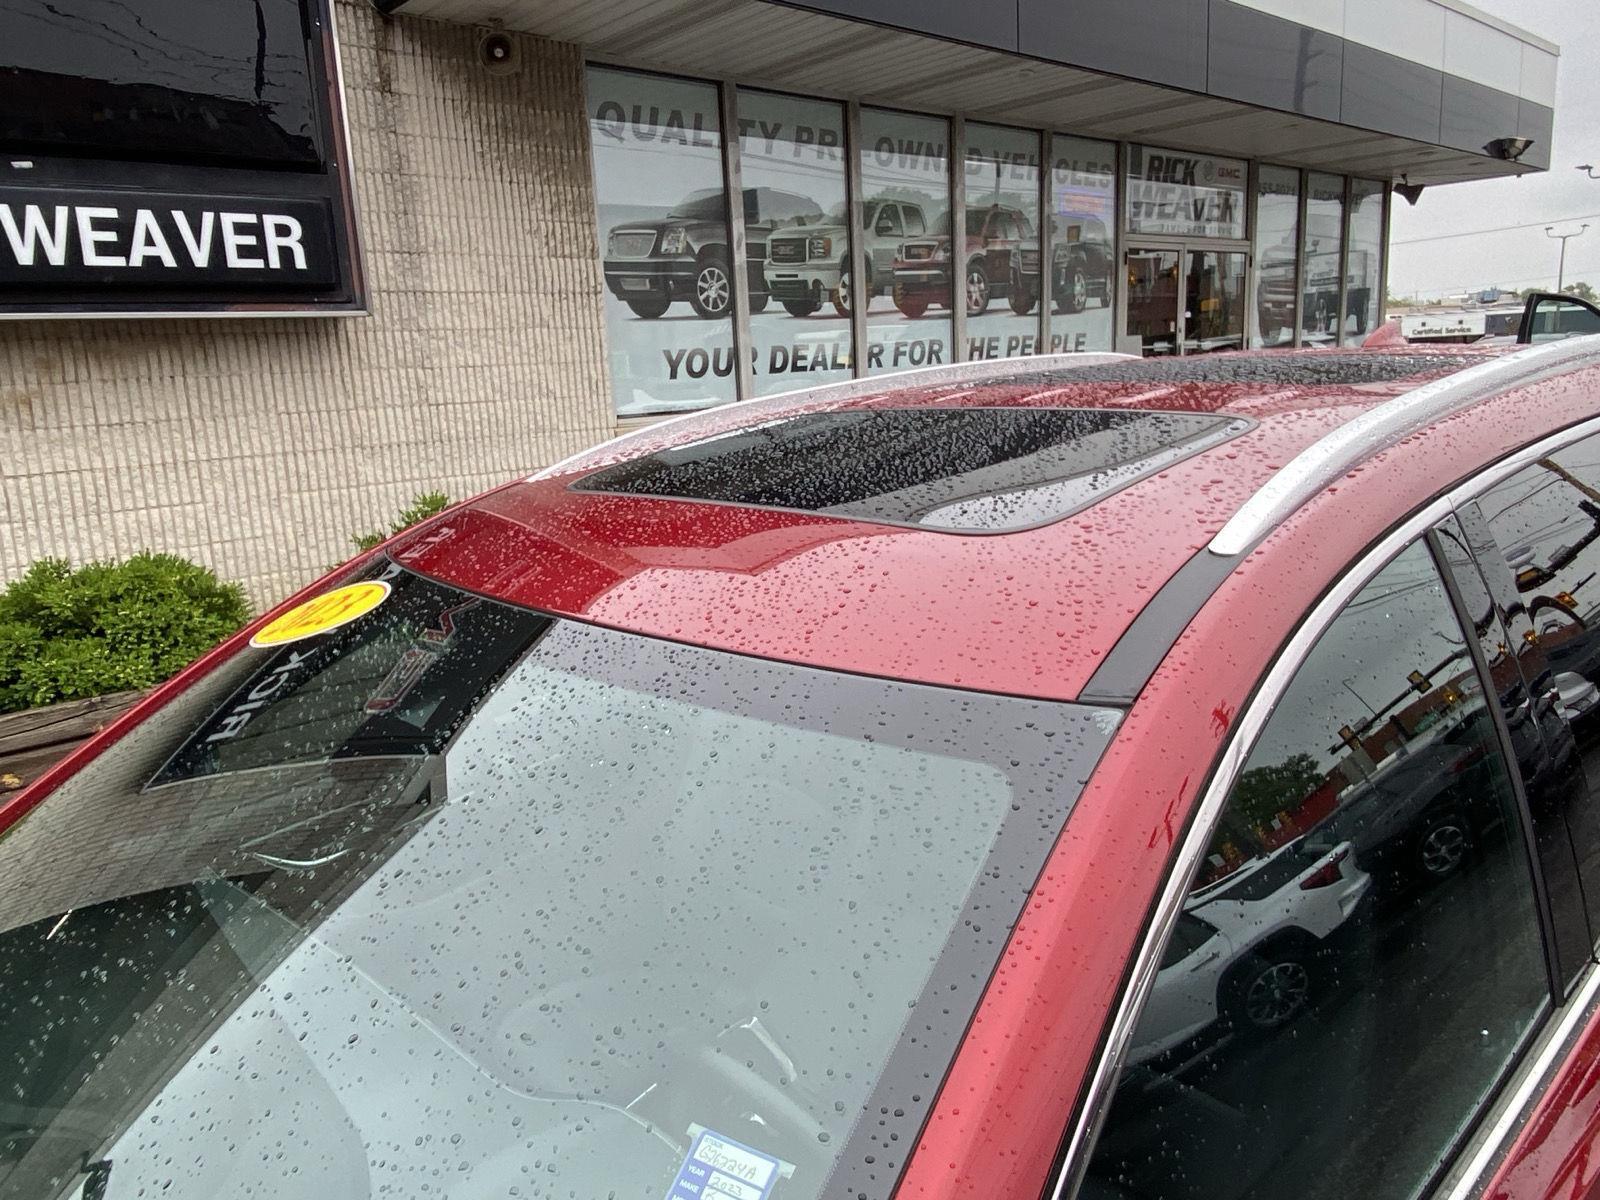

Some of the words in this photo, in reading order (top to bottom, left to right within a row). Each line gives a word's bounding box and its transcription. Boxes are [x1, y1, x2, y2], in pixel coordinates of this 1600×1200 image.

[595, 100, 782, 154] QUALTY
[793, 125, 983, 176] PR-OWND
[991, 150, 1112, 188] VECLES
[1147, 156, 1200, 186] RICK
[1217, 167, 1240, 178] GMC
[1133, 184, 1237, 223] WEAVER
[0, 204, 307, 270] WEAVER
[769, 343, 884, 374] DEALR
[893, 339, 943, 367] FOR
[967, 337, 1000, 361] HE
[687, 1164, 705, 1177] YEAR
[679, 1179, 700, 1194] MAKE
[711, 1176, 742, 1196] 2023
